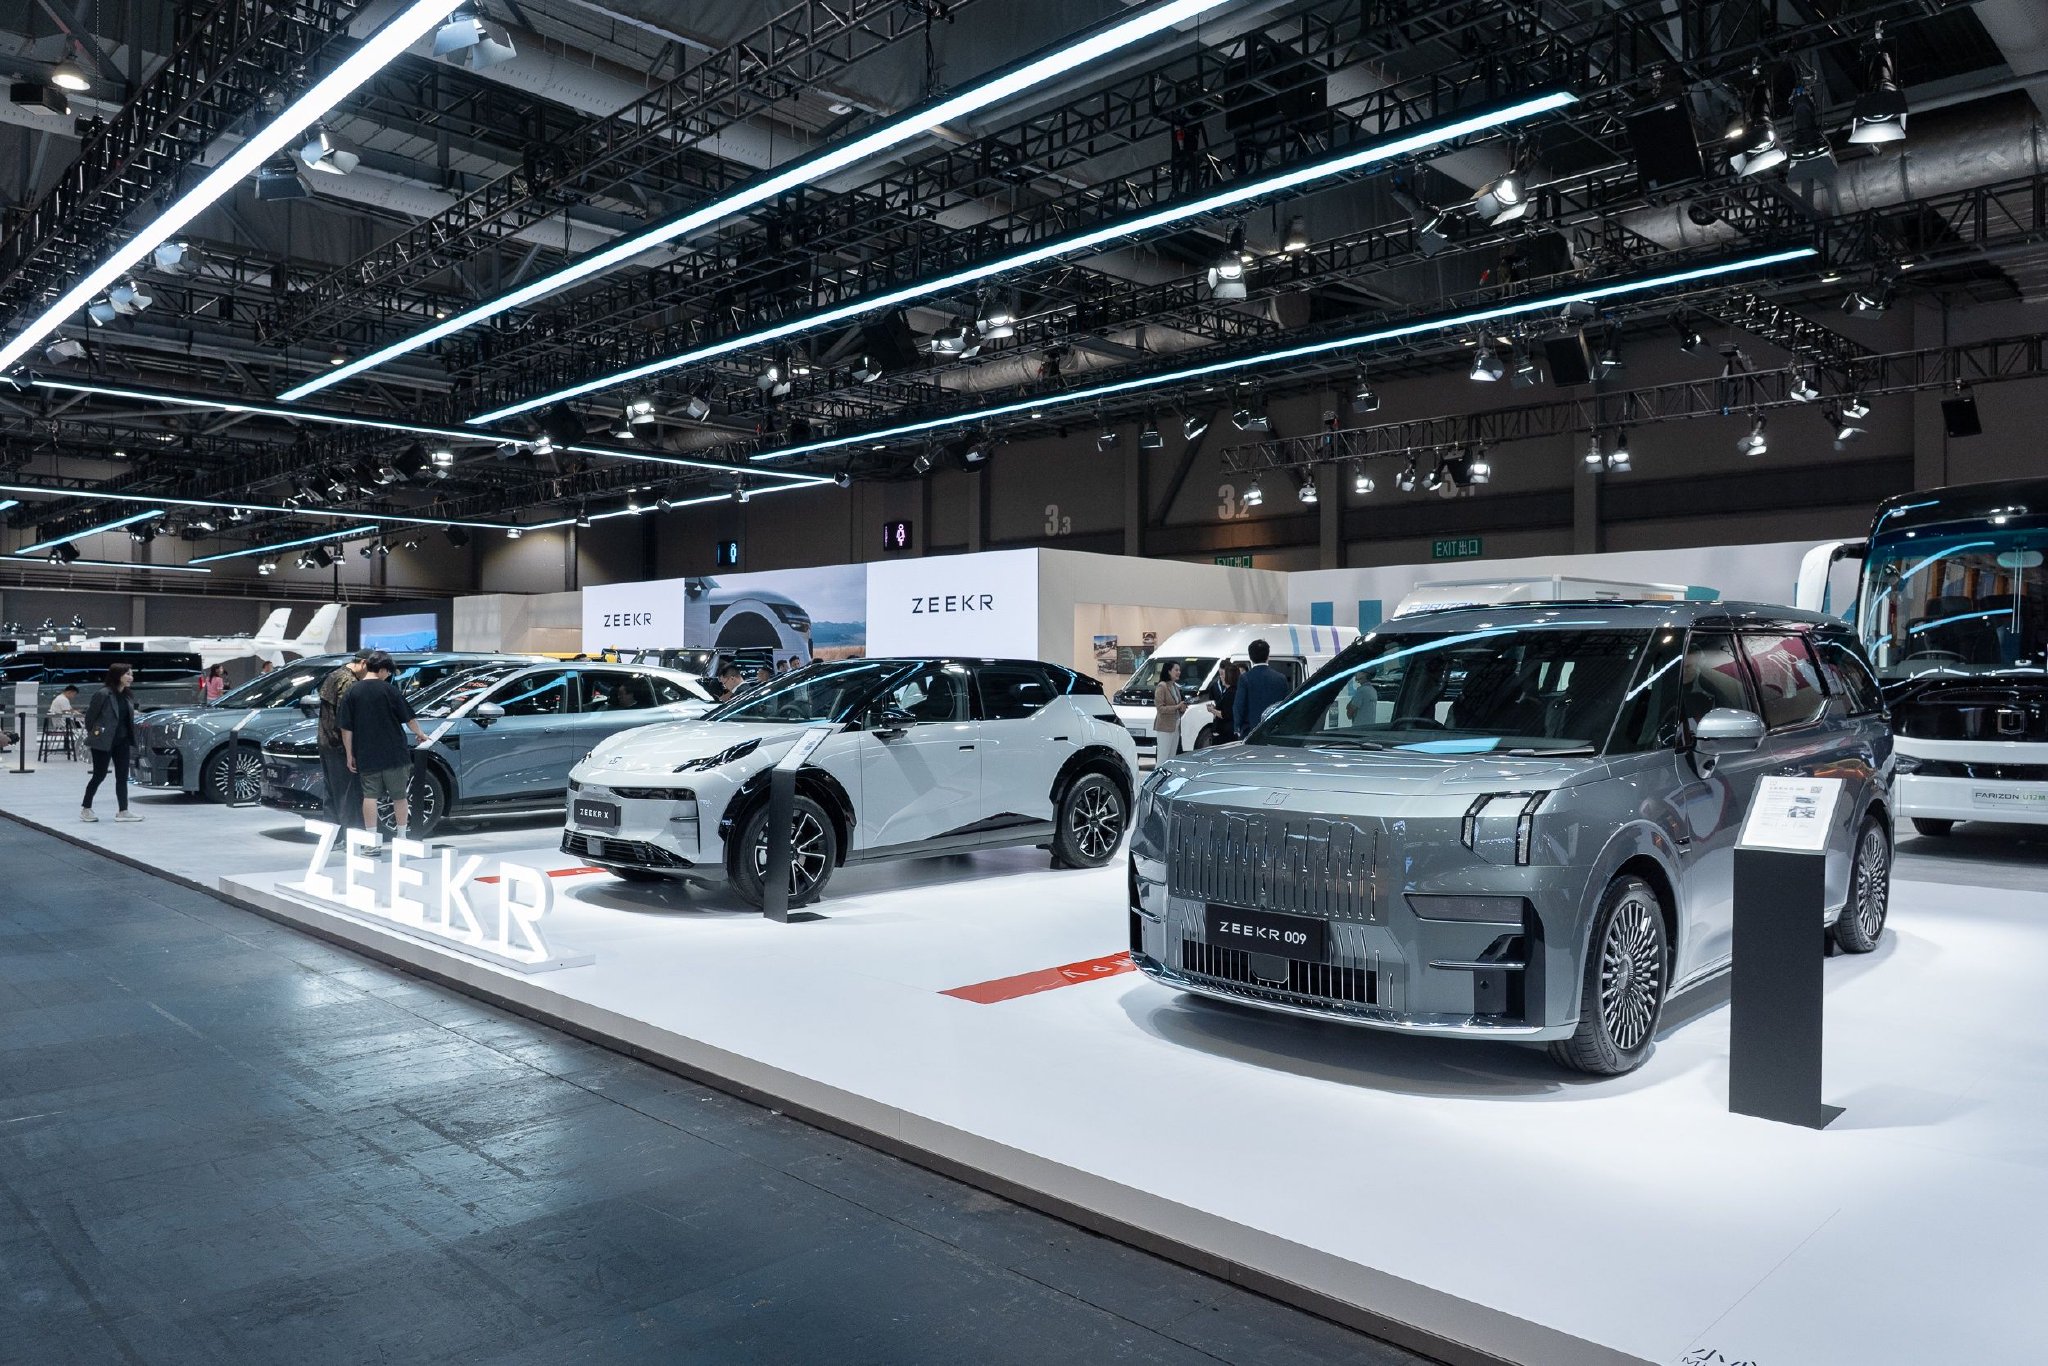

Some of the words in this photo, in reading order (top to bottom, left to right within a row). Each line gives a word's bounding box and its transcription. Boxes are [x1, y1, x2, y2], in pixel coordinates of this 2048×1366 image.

[1218, 484, 1250, 520] 3.2
[1045, 504, 1071, 537] 3.3
[1436, 541, 1457, 557] EXIT
[1458, 539, 1478, 555] 出口
[912, 594, 994, 614] ZEEKR
[604, 612, 652, 627] ZEEKR
[1975, 792, 2020, 800] FARIZON
[579, 808, 602, 818] ZEEKR
[604, 811, 609, 819] X
[304, 818, 554, 964] ZEEKR
[1219, 921, 1280, 941] ZEEKR
[1284, 930, 1307, 945] 009
